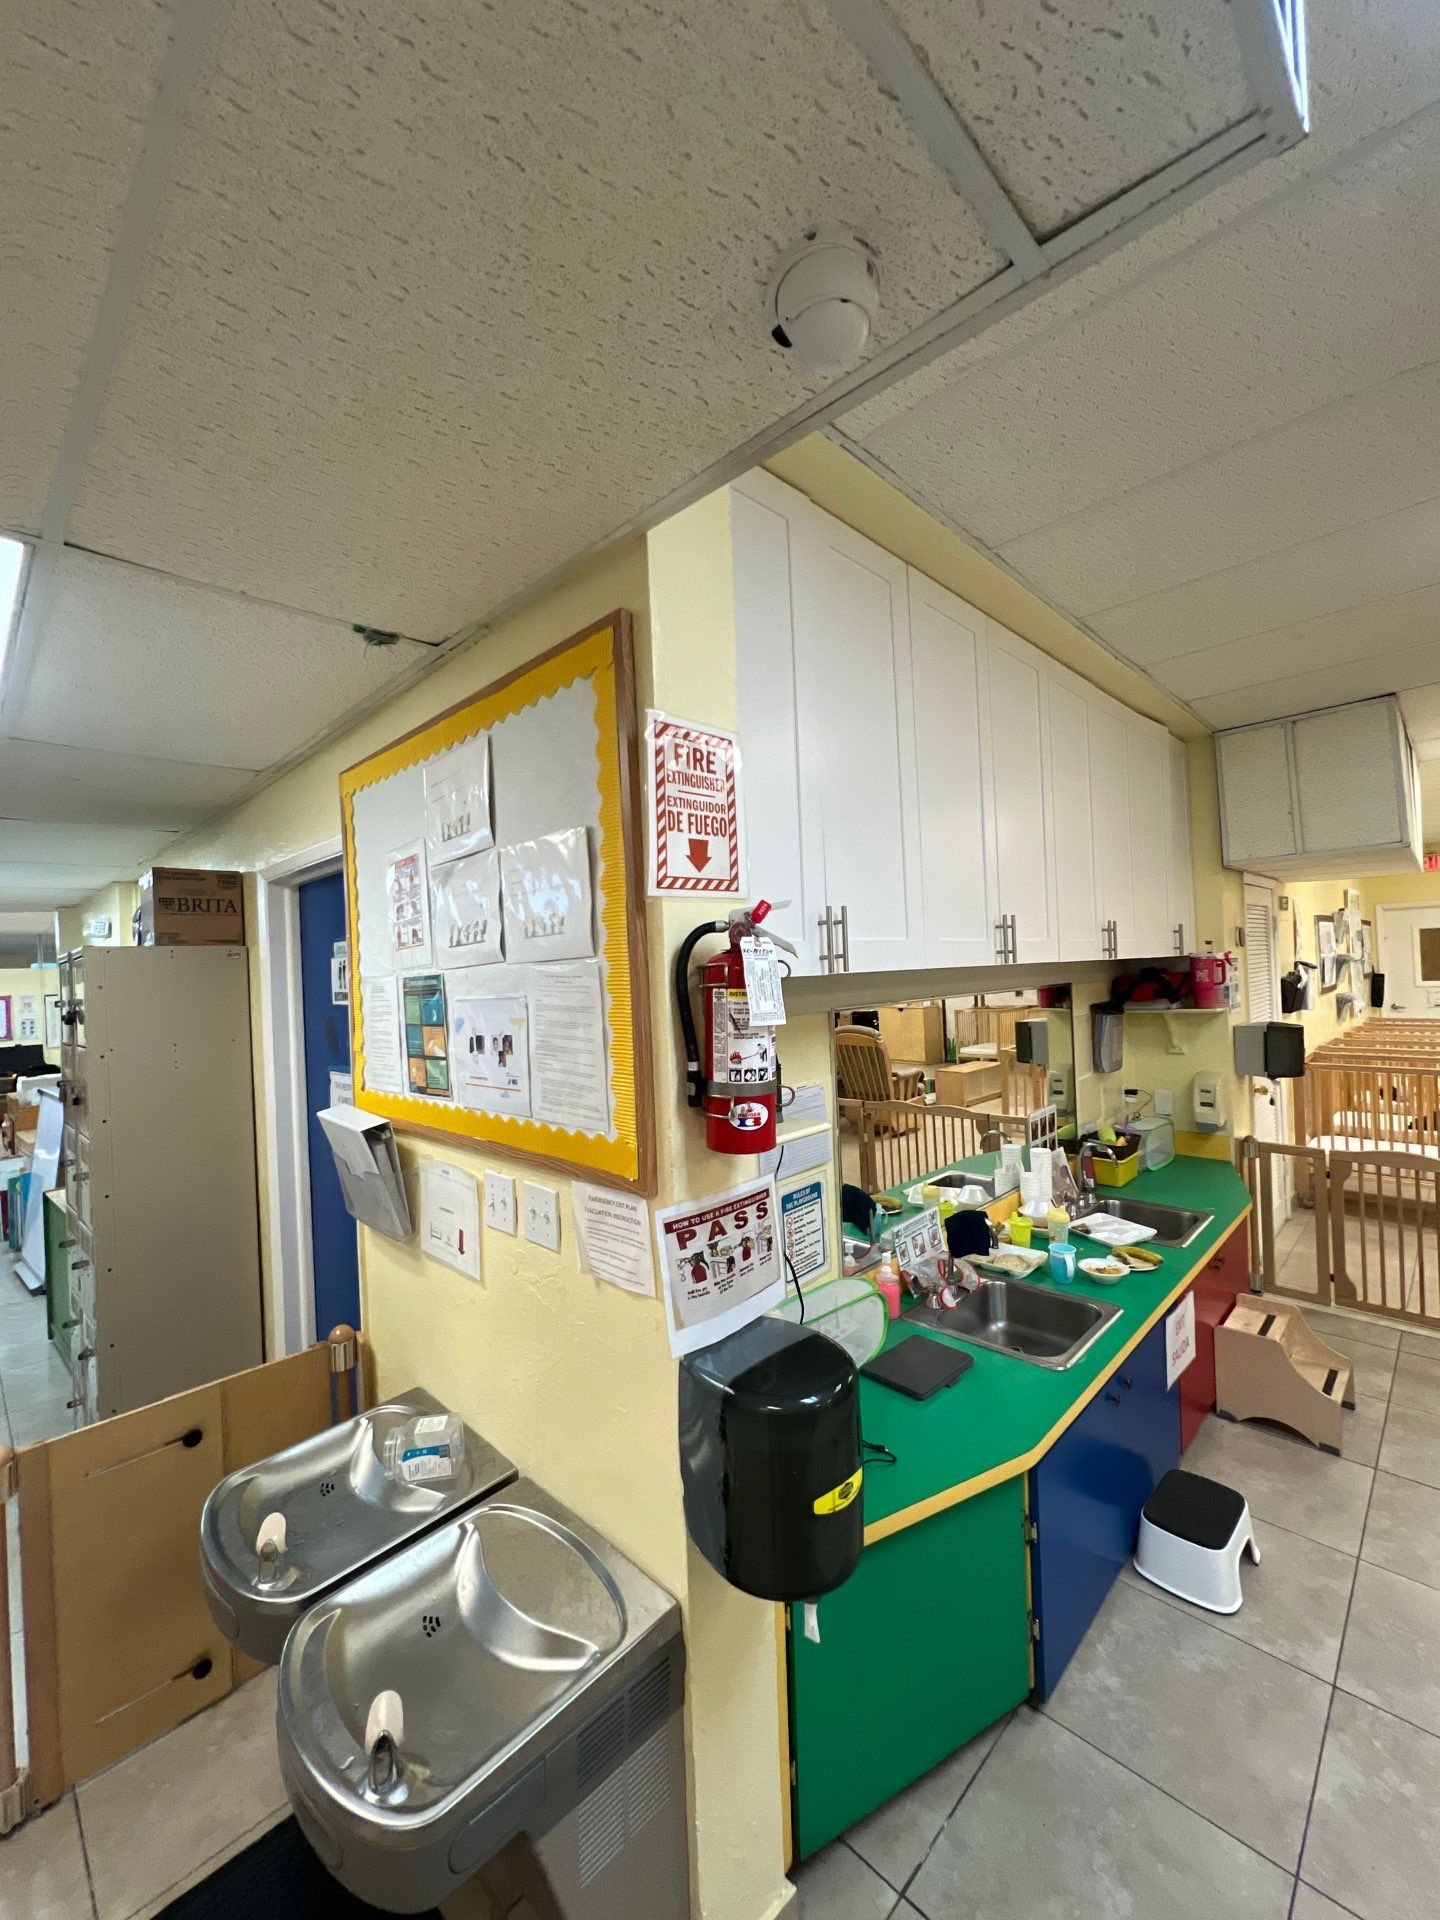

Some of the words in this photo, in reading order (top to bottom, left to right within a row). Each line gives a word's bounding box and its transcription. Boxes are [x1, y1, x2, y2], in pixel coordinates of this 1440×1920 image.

[673, 743, 717, 775] FIRE
[667, 770, 726, 792] EXTINGUISHER
[667, 795, 726, 815] EXTINGUIDOR
[668, 810, 684, 833] DE
[688, 813, 727, 838] FUEGO
[177, 897, 238, 913] BRITA
[672, 1221, 689, 1230] HOW
[702, 1213, 714, 1221] USE
